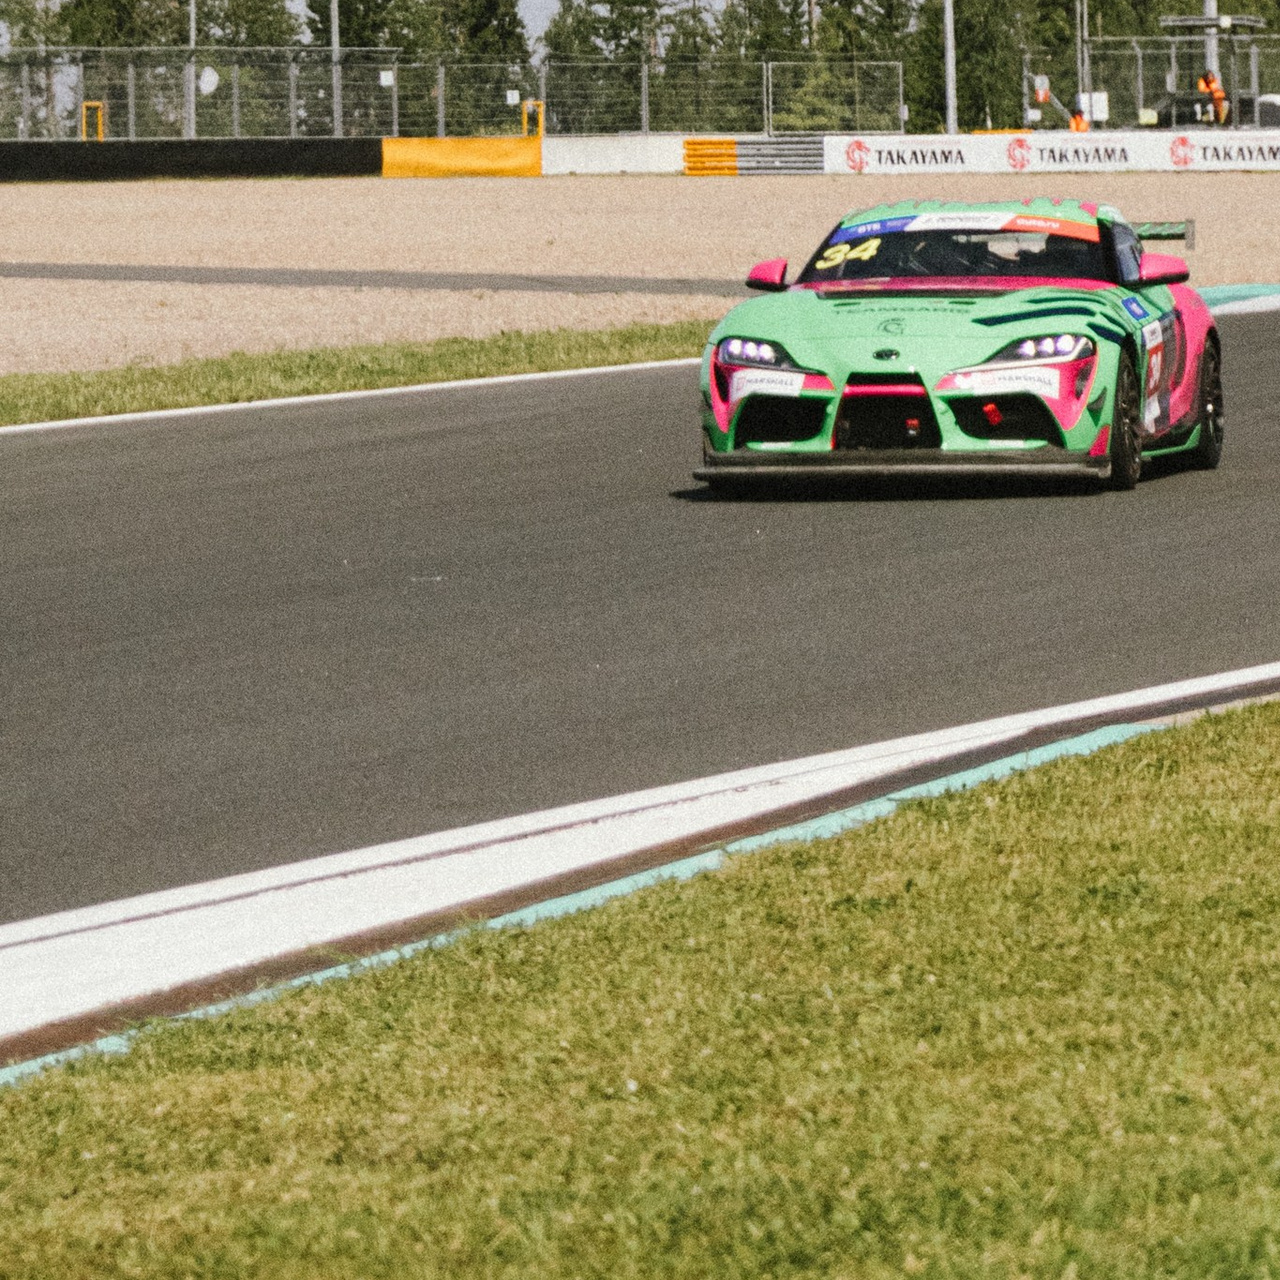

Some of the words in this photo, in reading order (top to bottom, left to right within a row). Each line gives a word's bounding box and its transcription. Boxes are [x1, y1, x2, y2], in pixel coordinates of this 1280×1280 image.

[876, 149, 965, 165] TAKAYAMA
[1039, 147, 1128, 163] TAKAYAMA
[815, 237, 881, 270] 34
[746, 376, 794, 387] MARSHALL
[997, 374, 1053, 387] MARSHALL
